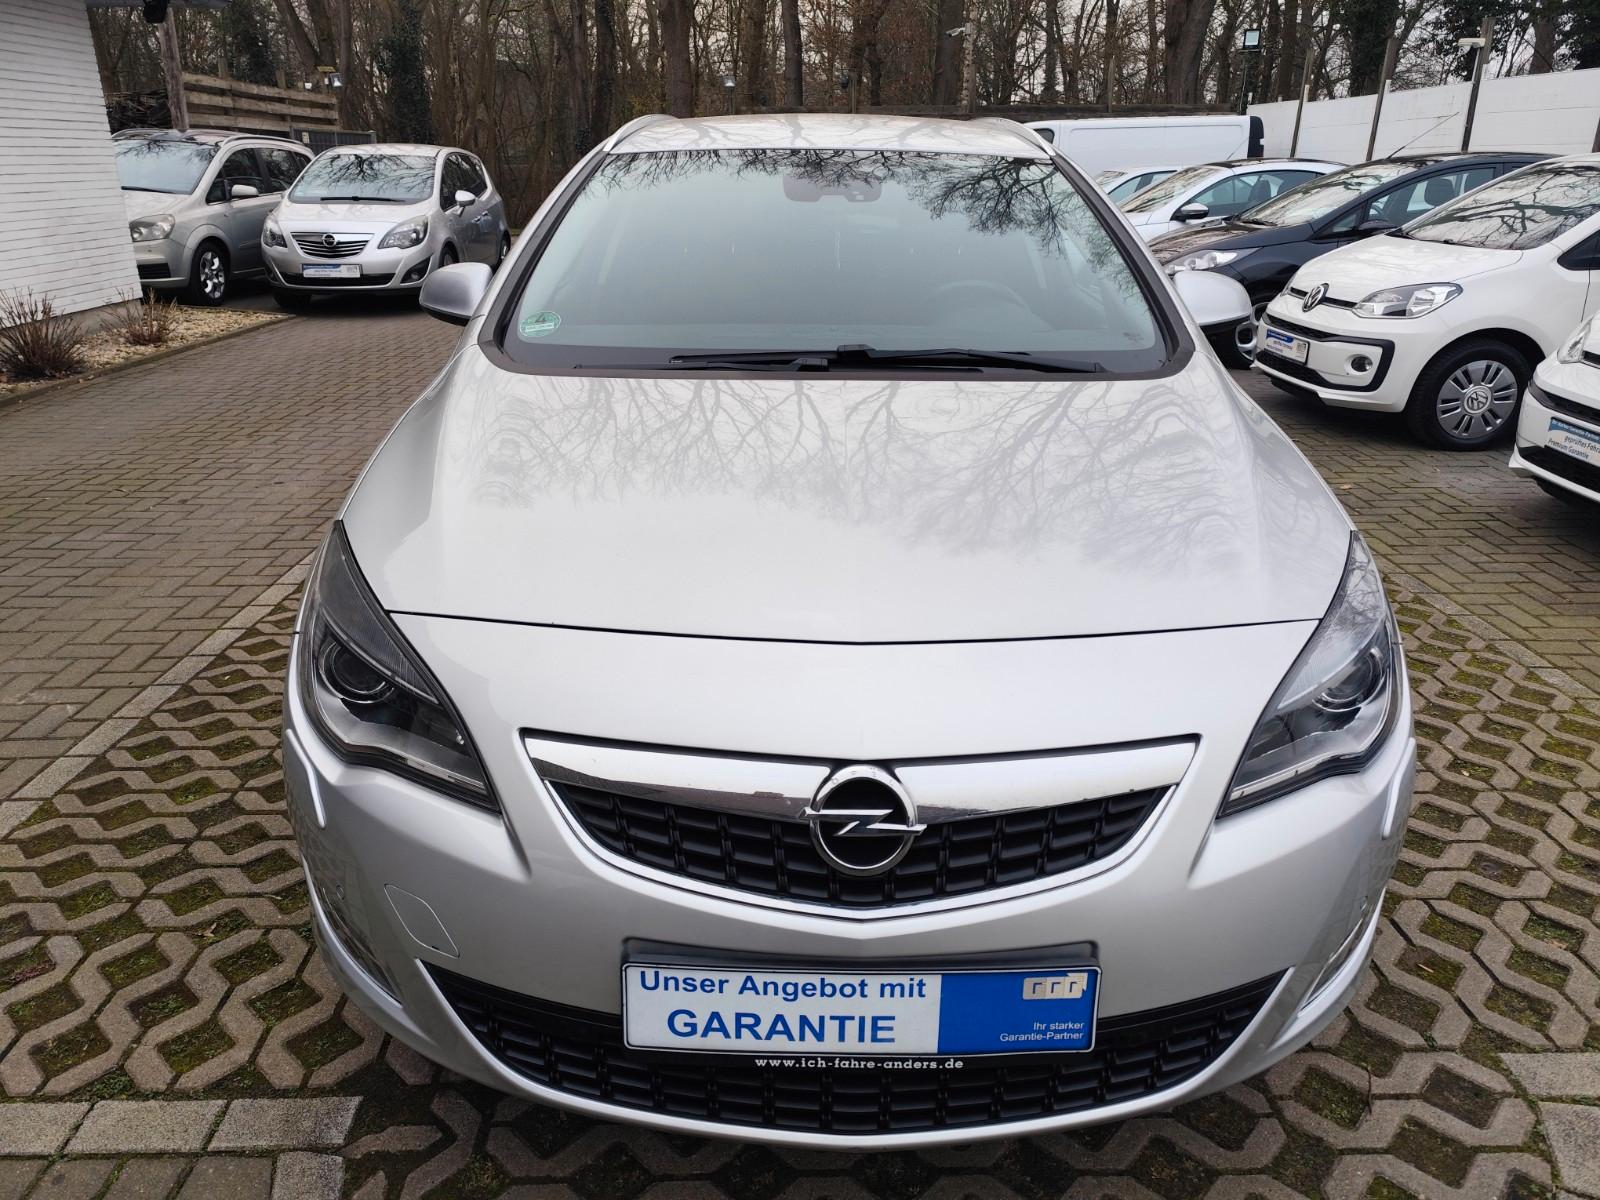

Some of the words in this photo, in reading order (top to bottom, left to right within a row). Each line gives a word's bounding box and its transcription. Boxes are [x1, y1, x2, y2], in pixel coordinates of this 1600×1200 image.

[639, 969, 729, 995] Unser
[738, 974, 868, 1002] Angebot
[879, 972, 926, 998] mit
[666, 1008, 896, 1044] GARANTIE
[1033, 1022, 1047, 1030] Ihr
[1050, 1021, 1084, 1030] starker
[1000, 1032, 1084, 1041] Garantie-Partner
[754, 1057, 965, 1070] www.ich-fahre-anders.de
